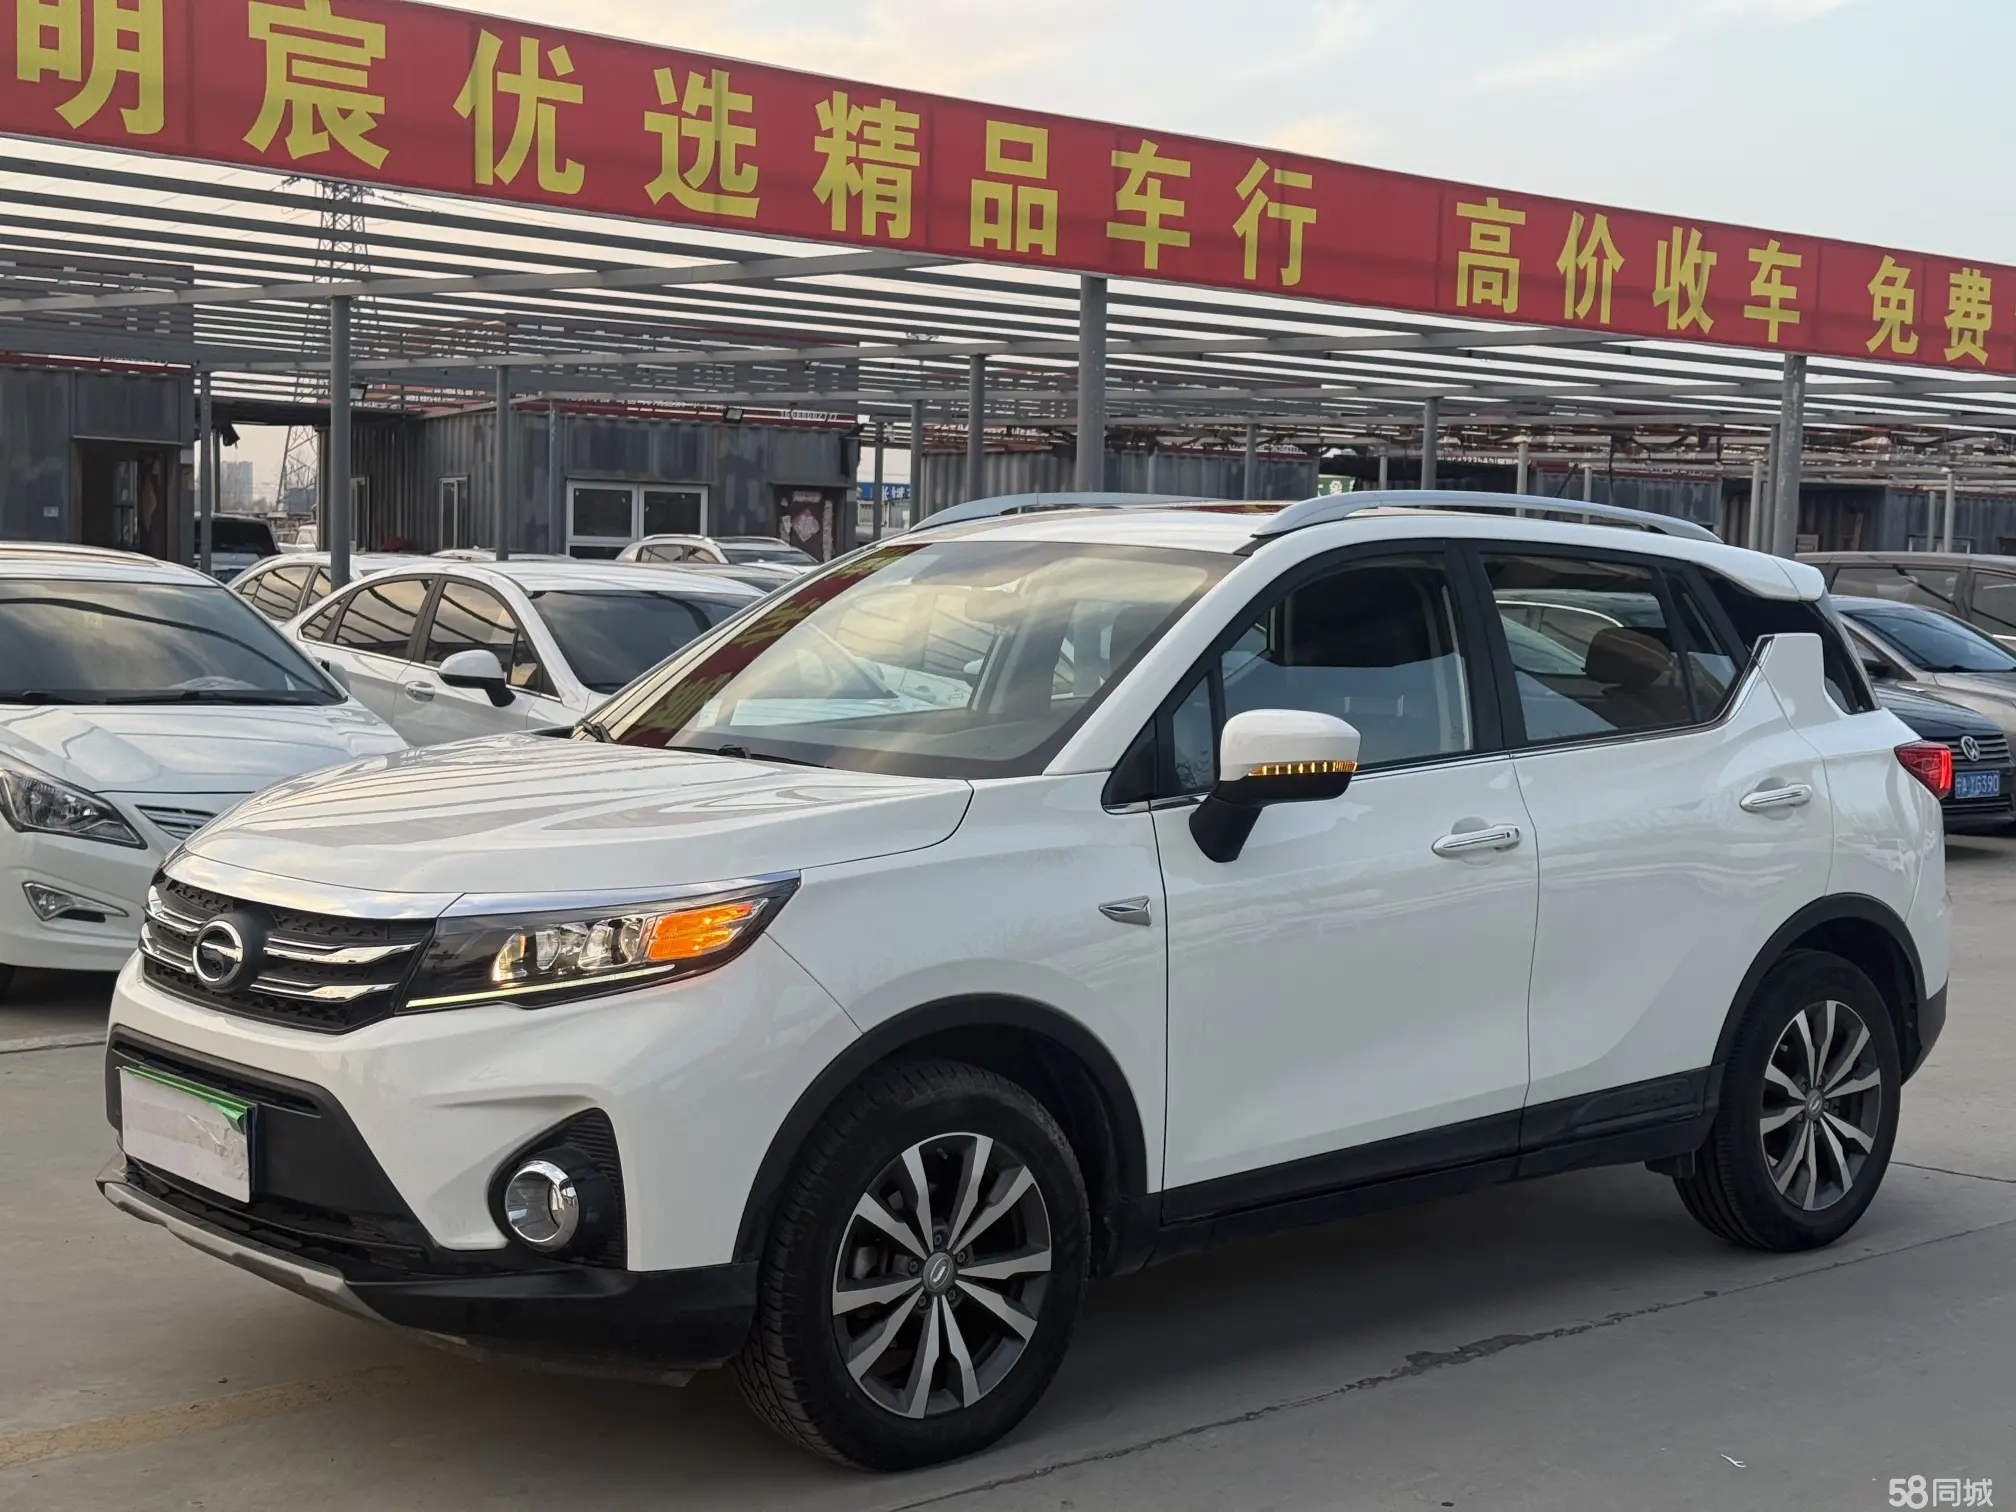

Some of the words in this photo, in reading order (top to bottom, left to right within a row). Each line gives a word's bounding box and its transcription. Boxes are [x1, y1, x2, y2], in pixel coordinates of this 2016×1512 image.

[17, 0, 1317, 286] 明宸优选精品车行
[1456, 197, 1802, 343] 高价收车
[1866, 255, 1992, 365] 免费
